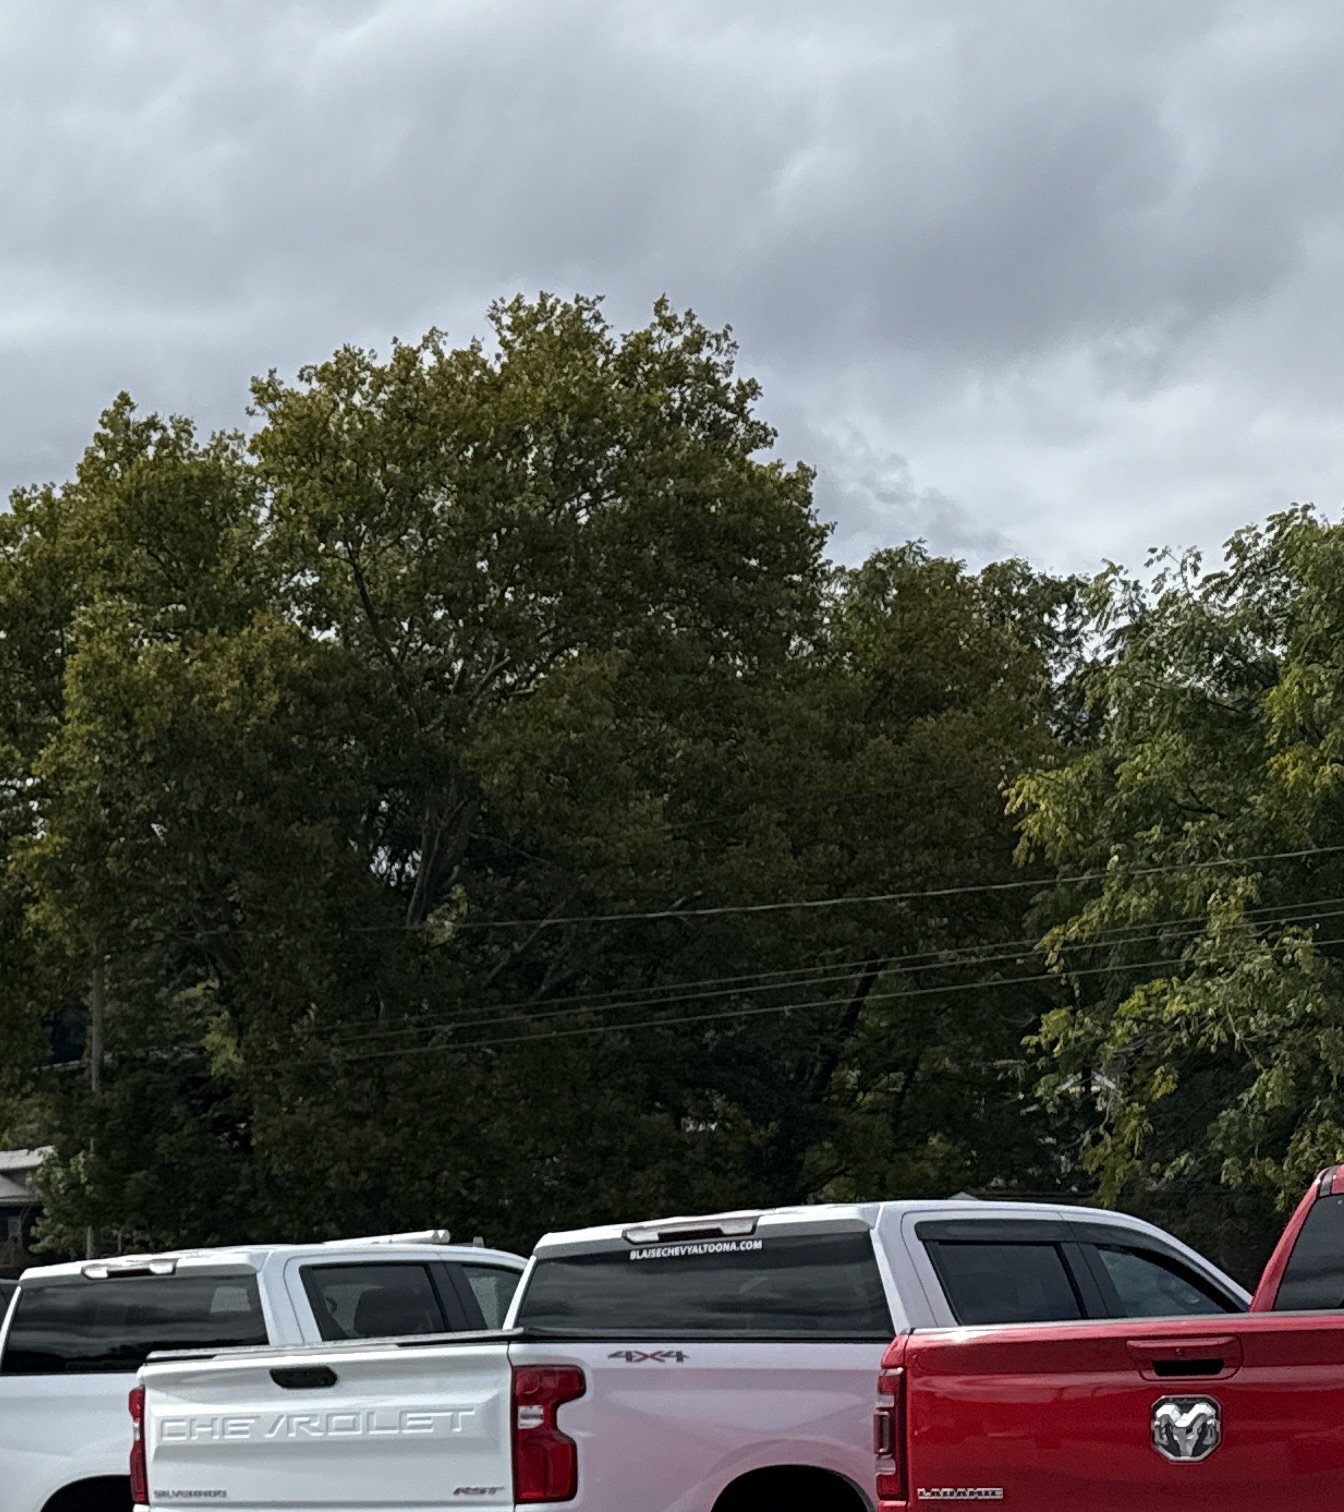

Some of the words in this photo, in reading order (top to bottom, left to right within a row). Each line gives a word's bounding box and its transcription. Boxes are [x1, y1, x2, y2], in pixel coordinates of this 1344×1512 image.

[630, 1240, 762, 1261] BLAISECHEVYALTOONA.COM
[161, 1408, 477, 1441] CHEVROLET
[453, 1486, 505, 1496] RST
